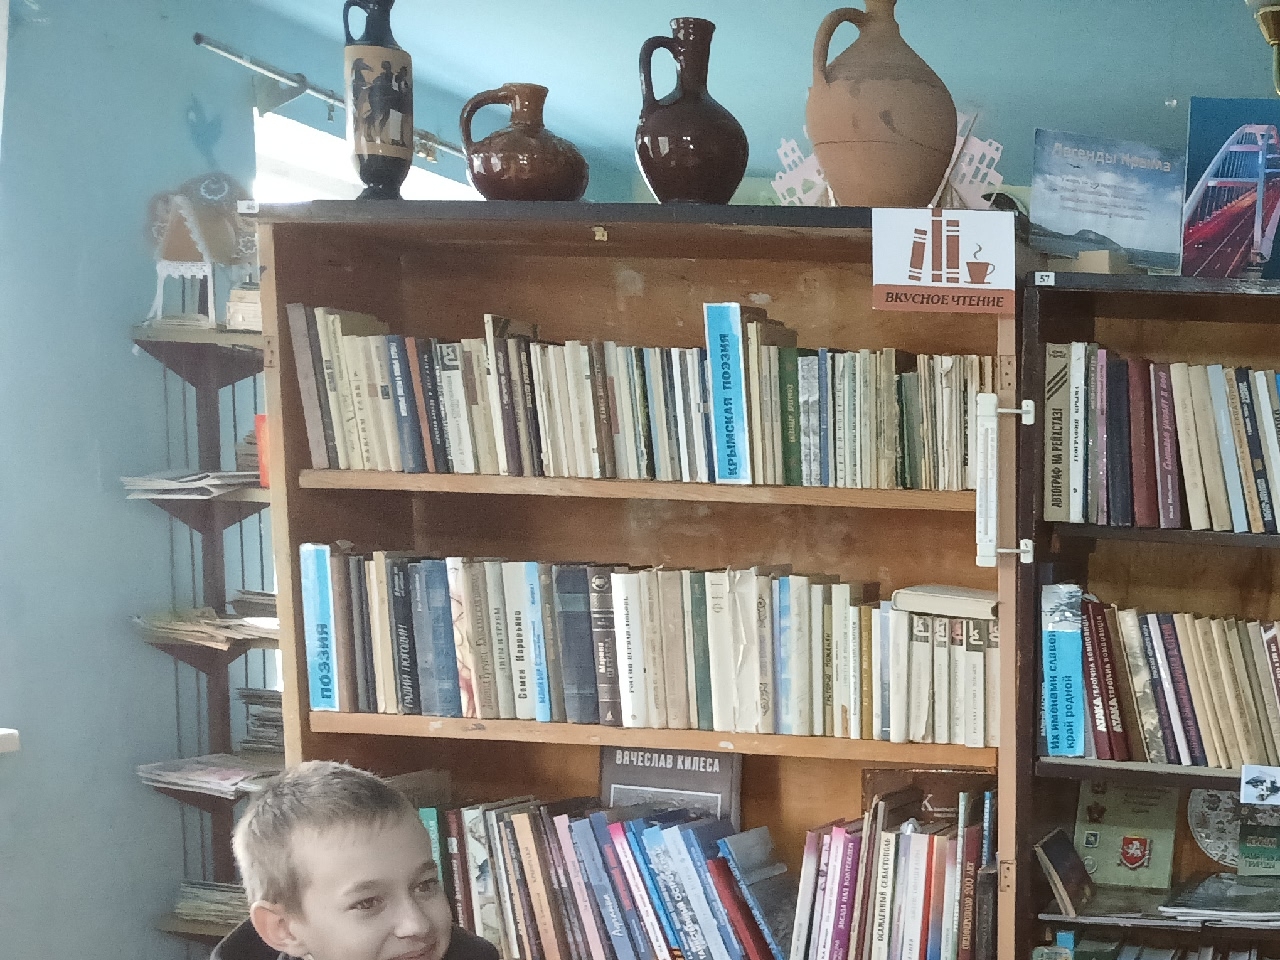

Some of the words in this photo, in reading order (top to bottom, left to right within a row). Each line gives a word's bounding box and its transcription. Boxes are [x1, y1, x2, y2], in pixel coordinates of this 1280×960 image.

[1052, 142, 1117, 164] Легенды
[1039, 274, 1050, 282] 57
[885, 292, 949, 305] ВКУСНОЕ
[952, 295, 1004, 308] ЧТЕНИЕ
[719, 333, 732, 390] ПОЭЗИЯ
[724, 397, 737, 475] КРЫМСКАЯ
[1051, 454, 1062, 465] НА
[1051, 467, 1062, 508] АВТОГРАФ
[317, 623, 331, 699] ПОЭЗИЯ
[597, 642, 606, 674] Марина
[1049, 675, 1059, 730] именами
[1062, 675, 1074, 718] родной
[1092, 697, 1106, 732] АТАКА
[1109, 697, 1122, 732] АТАКА
[1049, 734, 1059, 749] Их
[1064, 722, 1075, 749] край
[615, 750, 673, 769] ВЯЧЕСЛАВ
[677, 754, 720, 773] КИЛЕСА
[965, 878, 974, 895] 200
